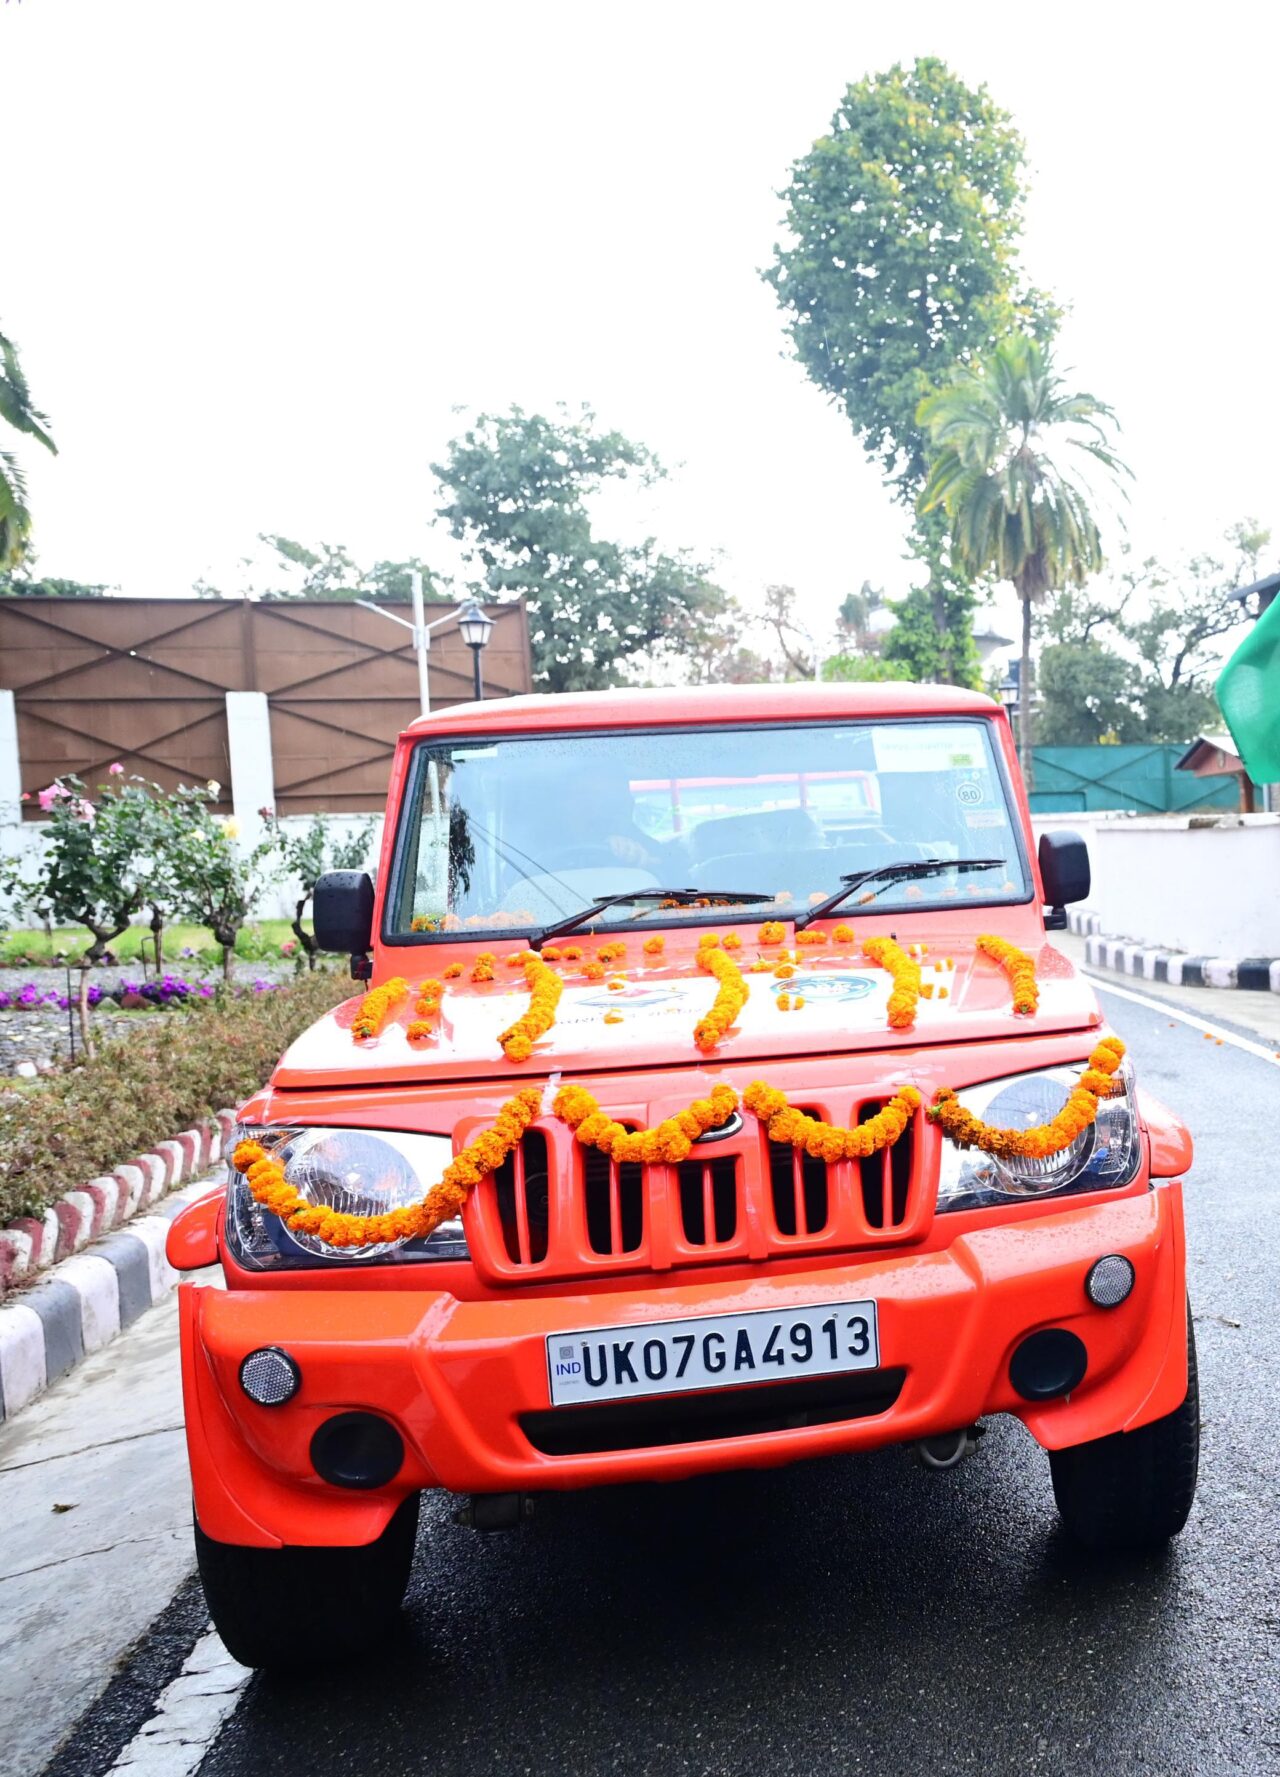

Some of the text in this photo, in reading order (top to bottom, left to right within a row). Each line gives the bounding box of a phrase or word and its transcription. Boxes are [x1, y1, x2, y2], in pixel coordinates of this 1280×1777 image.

[962, 790, 978, 801] 80
[556, 1315, 871, 1387] IND UK07GA4913
